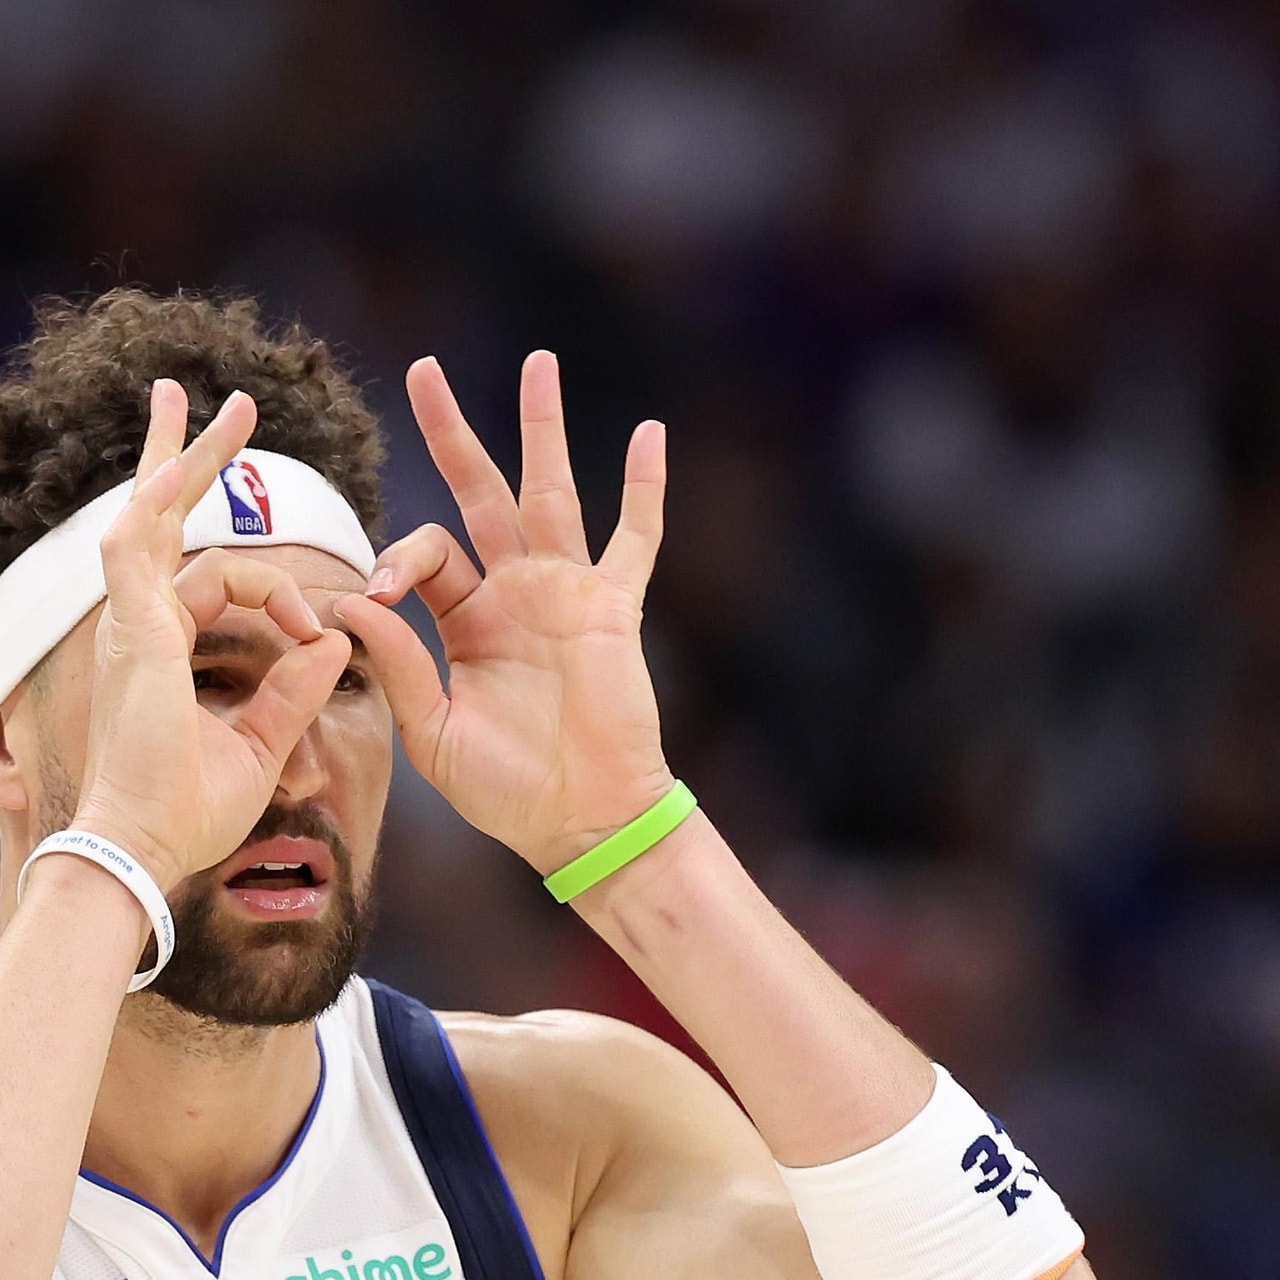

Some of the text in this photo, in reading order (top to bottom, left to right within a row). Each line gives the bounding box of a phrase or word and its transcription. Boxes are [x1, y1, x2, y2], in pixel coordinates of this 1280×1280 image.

[234, 516, 262, 532] NBA
[84, 837, 99, 850] to
[100, 847, 133, 873] come
